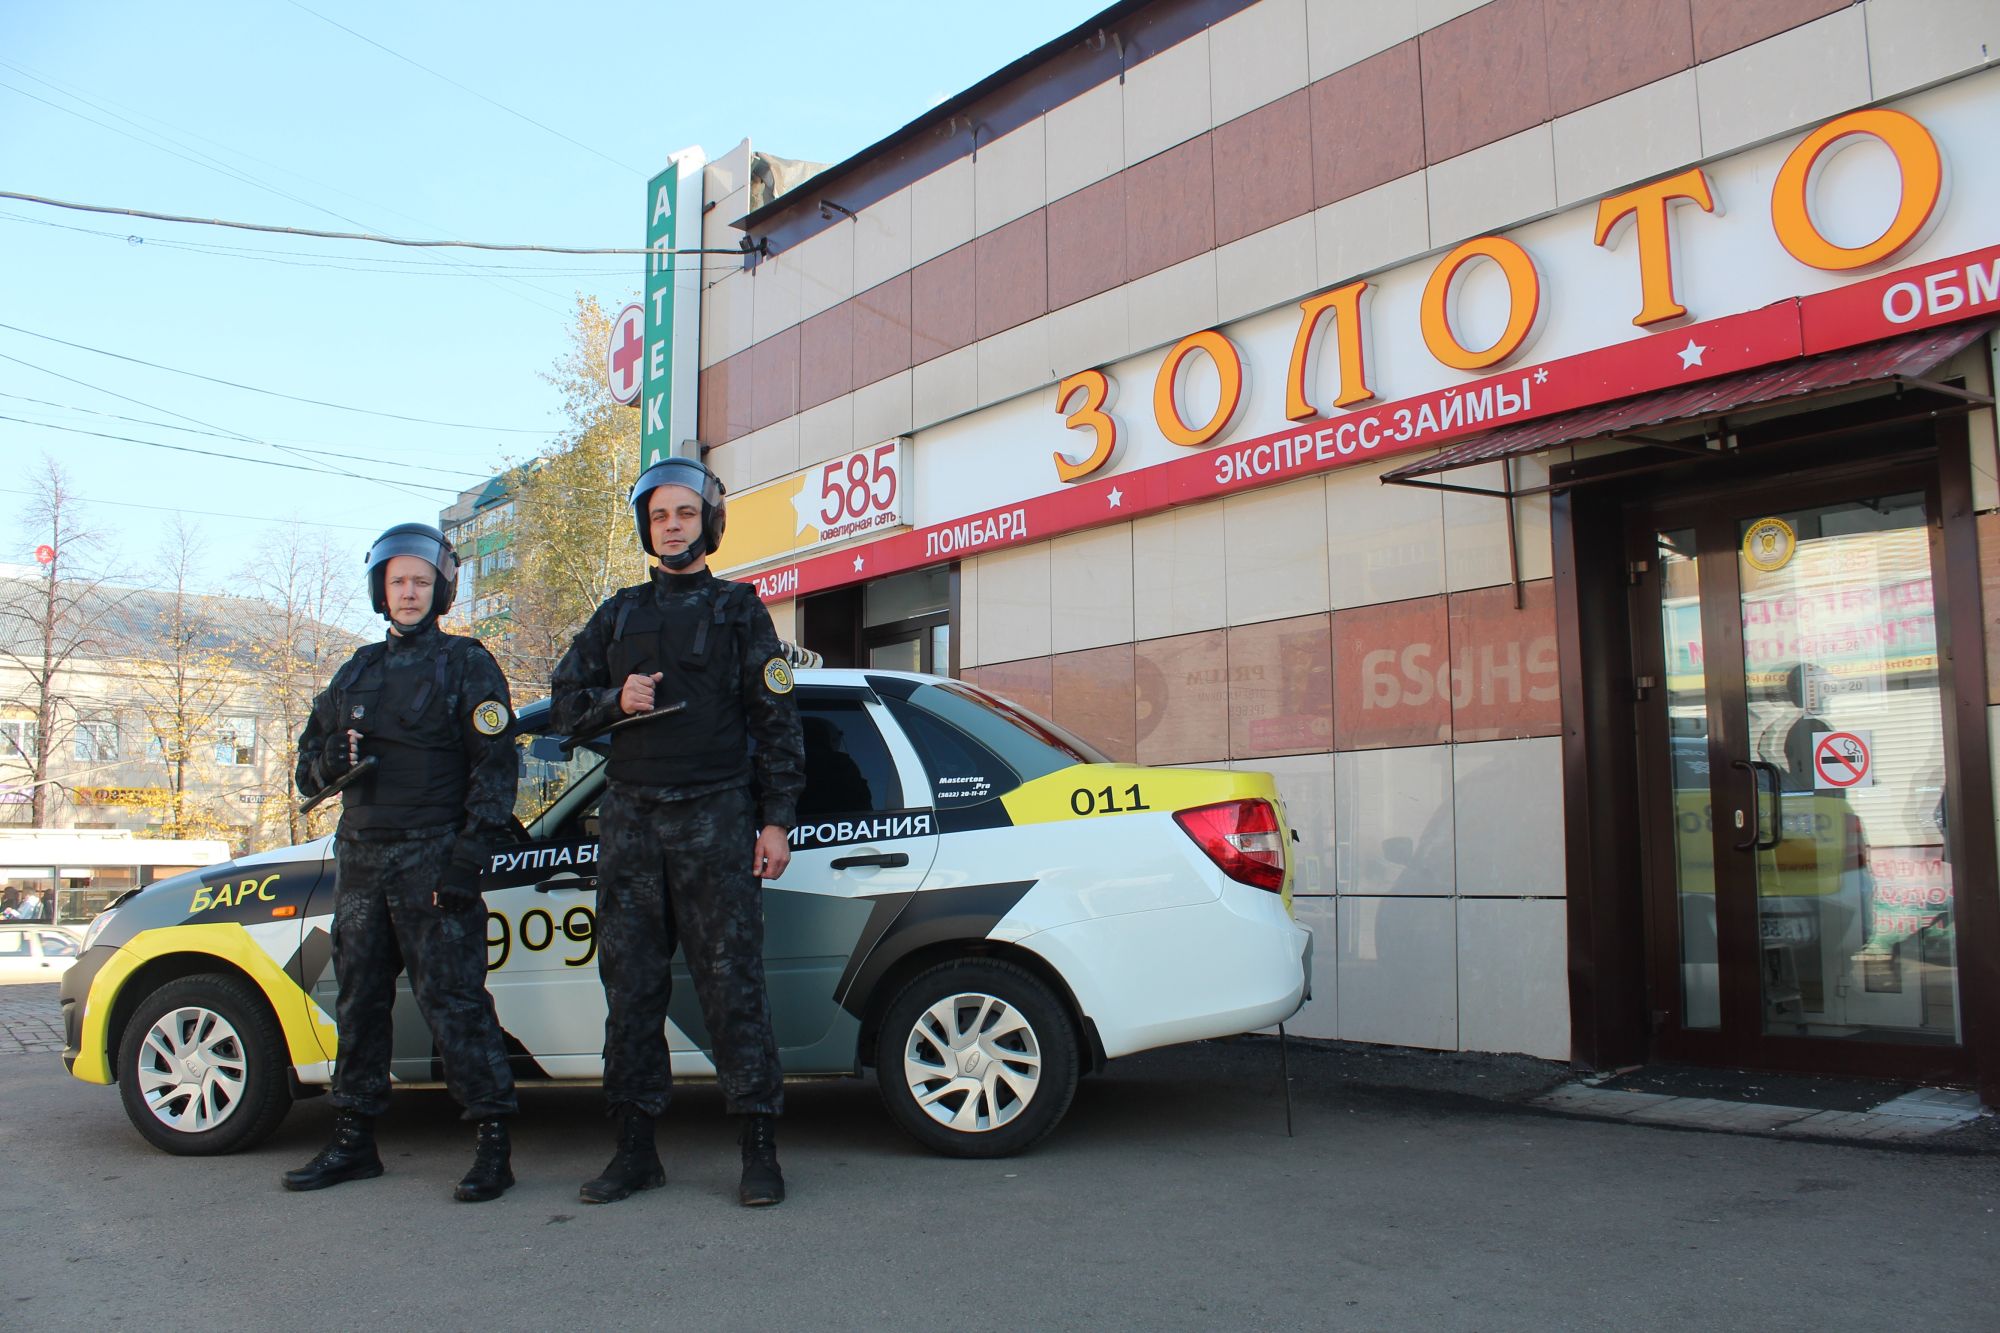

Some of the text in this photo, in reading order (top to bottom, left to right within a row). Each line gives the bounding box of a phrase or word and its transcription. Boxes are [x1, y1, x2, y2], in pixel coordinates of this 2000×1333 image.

[1053, 108, 1943, 483] ЗОЛОТО
[820, 443, 897, 525] 585
[820, 511, 897, 542] ювелирная сеть
[925, 508, 1027, 558] ЛОМБАРД
[1070, 783, 1151, 816] 011
[480, 847, 572, 874] РУППА
[189, 874, 281, 913] БАРС
